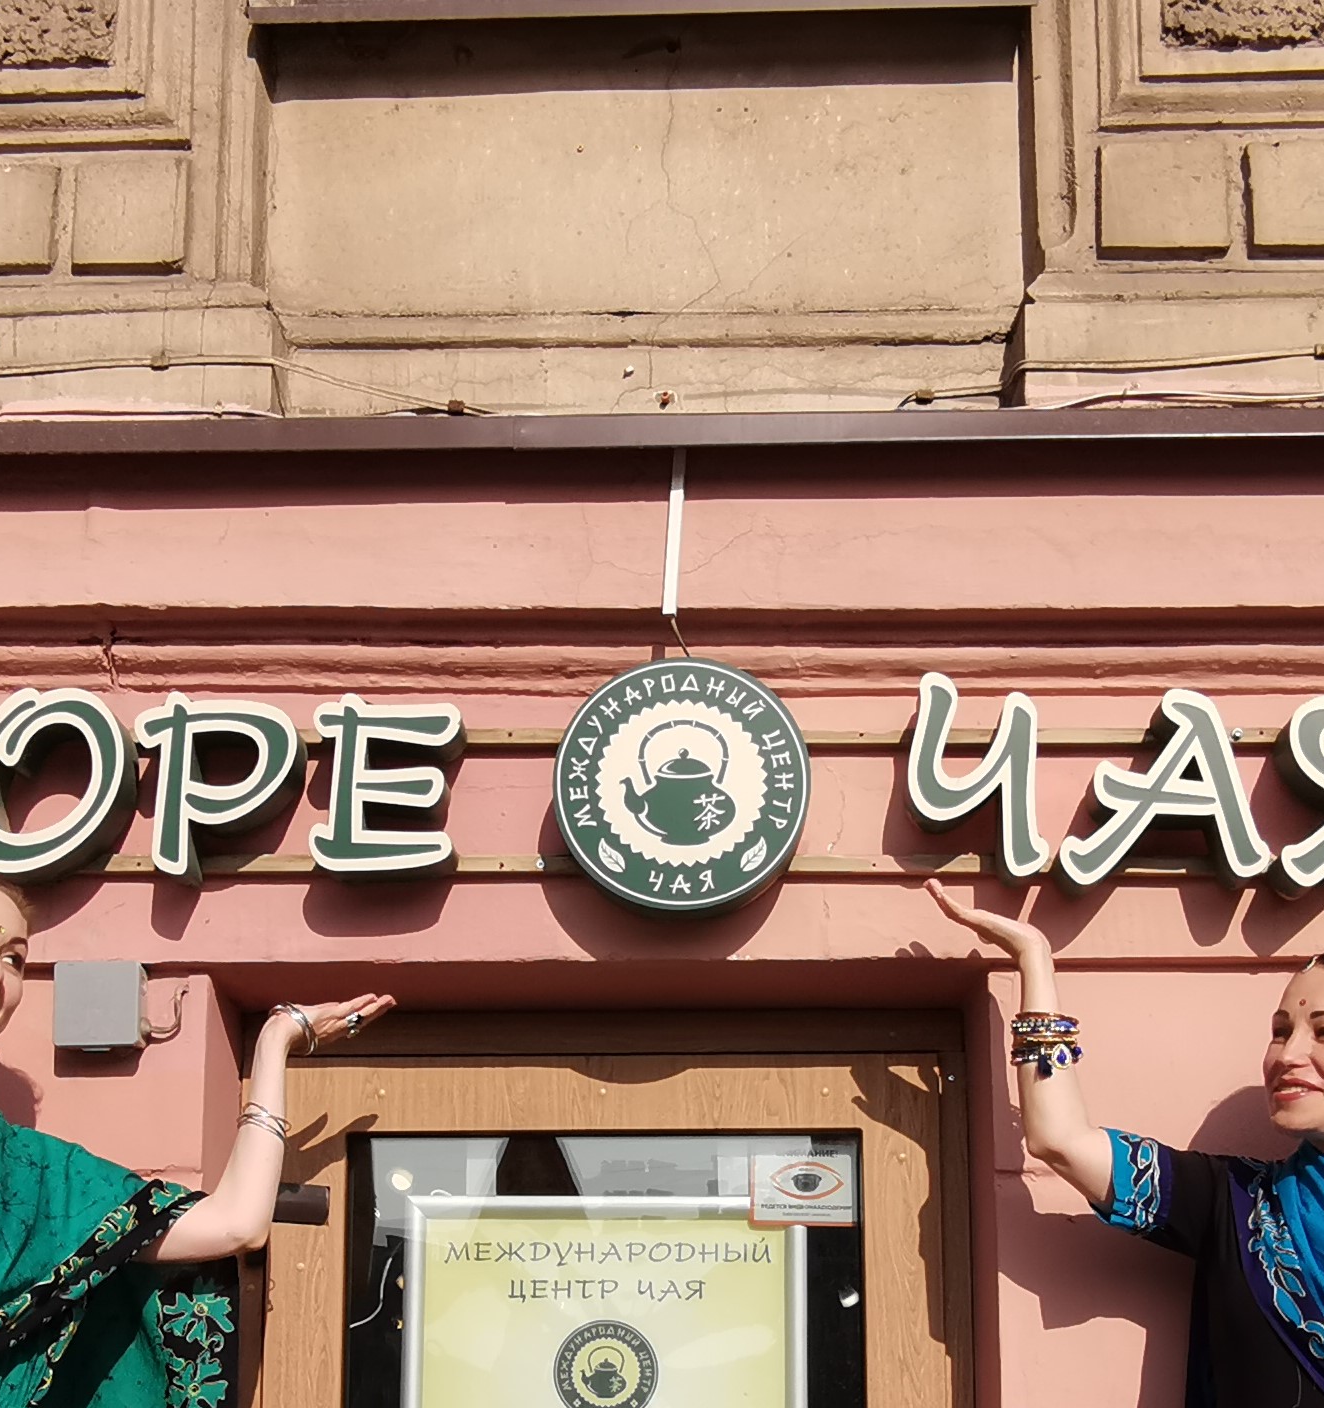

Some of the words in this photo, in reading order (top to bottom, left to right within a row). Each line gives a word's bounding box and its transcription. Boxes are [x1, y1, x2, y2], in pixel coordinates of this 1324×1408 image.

[568, 673, 767, 828] МЕЖДУНАРОДНЫЙ
[761, 729, 795, 829] ЦЕНТР
[693, 793, 726, 832] 茶
[648, 869, 716, 894] ЧАЯ
[444, 1237, 772, 1267] МЕЖДУНАРОДНЫЙ
[508, 1279, 619, 1303] ЦЕНТР
[637, 1279, 706, 1302] ЧАЯ
